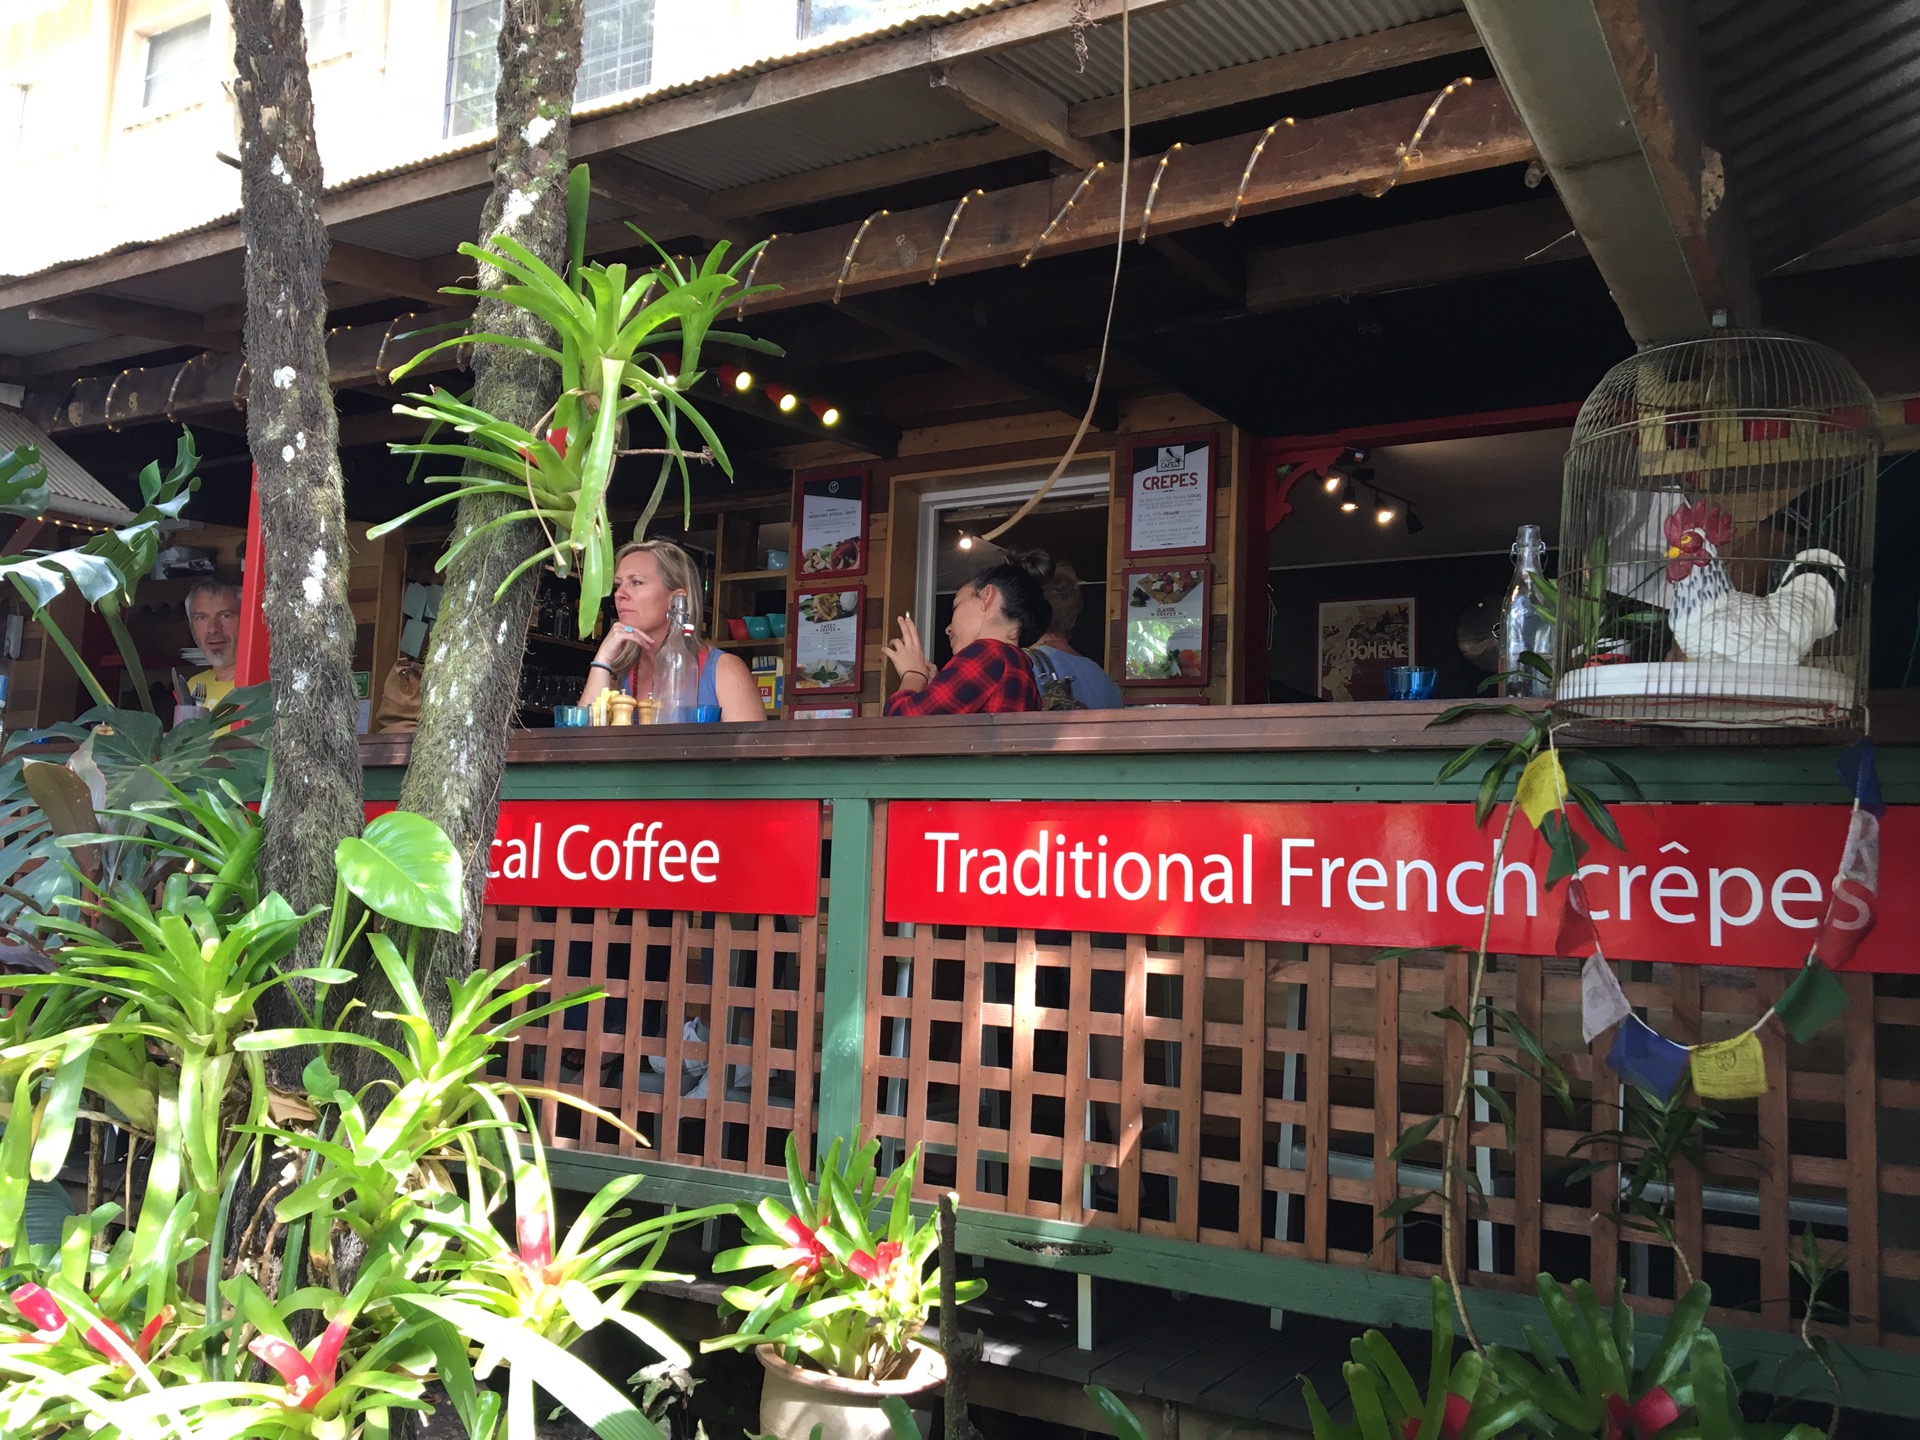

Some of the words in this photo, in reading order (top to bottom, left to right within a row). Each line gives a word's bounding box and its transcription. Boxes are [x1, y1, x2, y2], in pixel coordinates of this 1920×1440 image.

[1142, 472, 1198, 491] CREPES
[1346, 637, 1408, 660] BOHEME
[486, 822, 542, 879] cal
[556, 821, 720, 883] Coffee
[924, 830, 1253, 904] Traditional
[1281, 838, 1537, 917] French
[1568, 840, 1870, 948] crêpes
